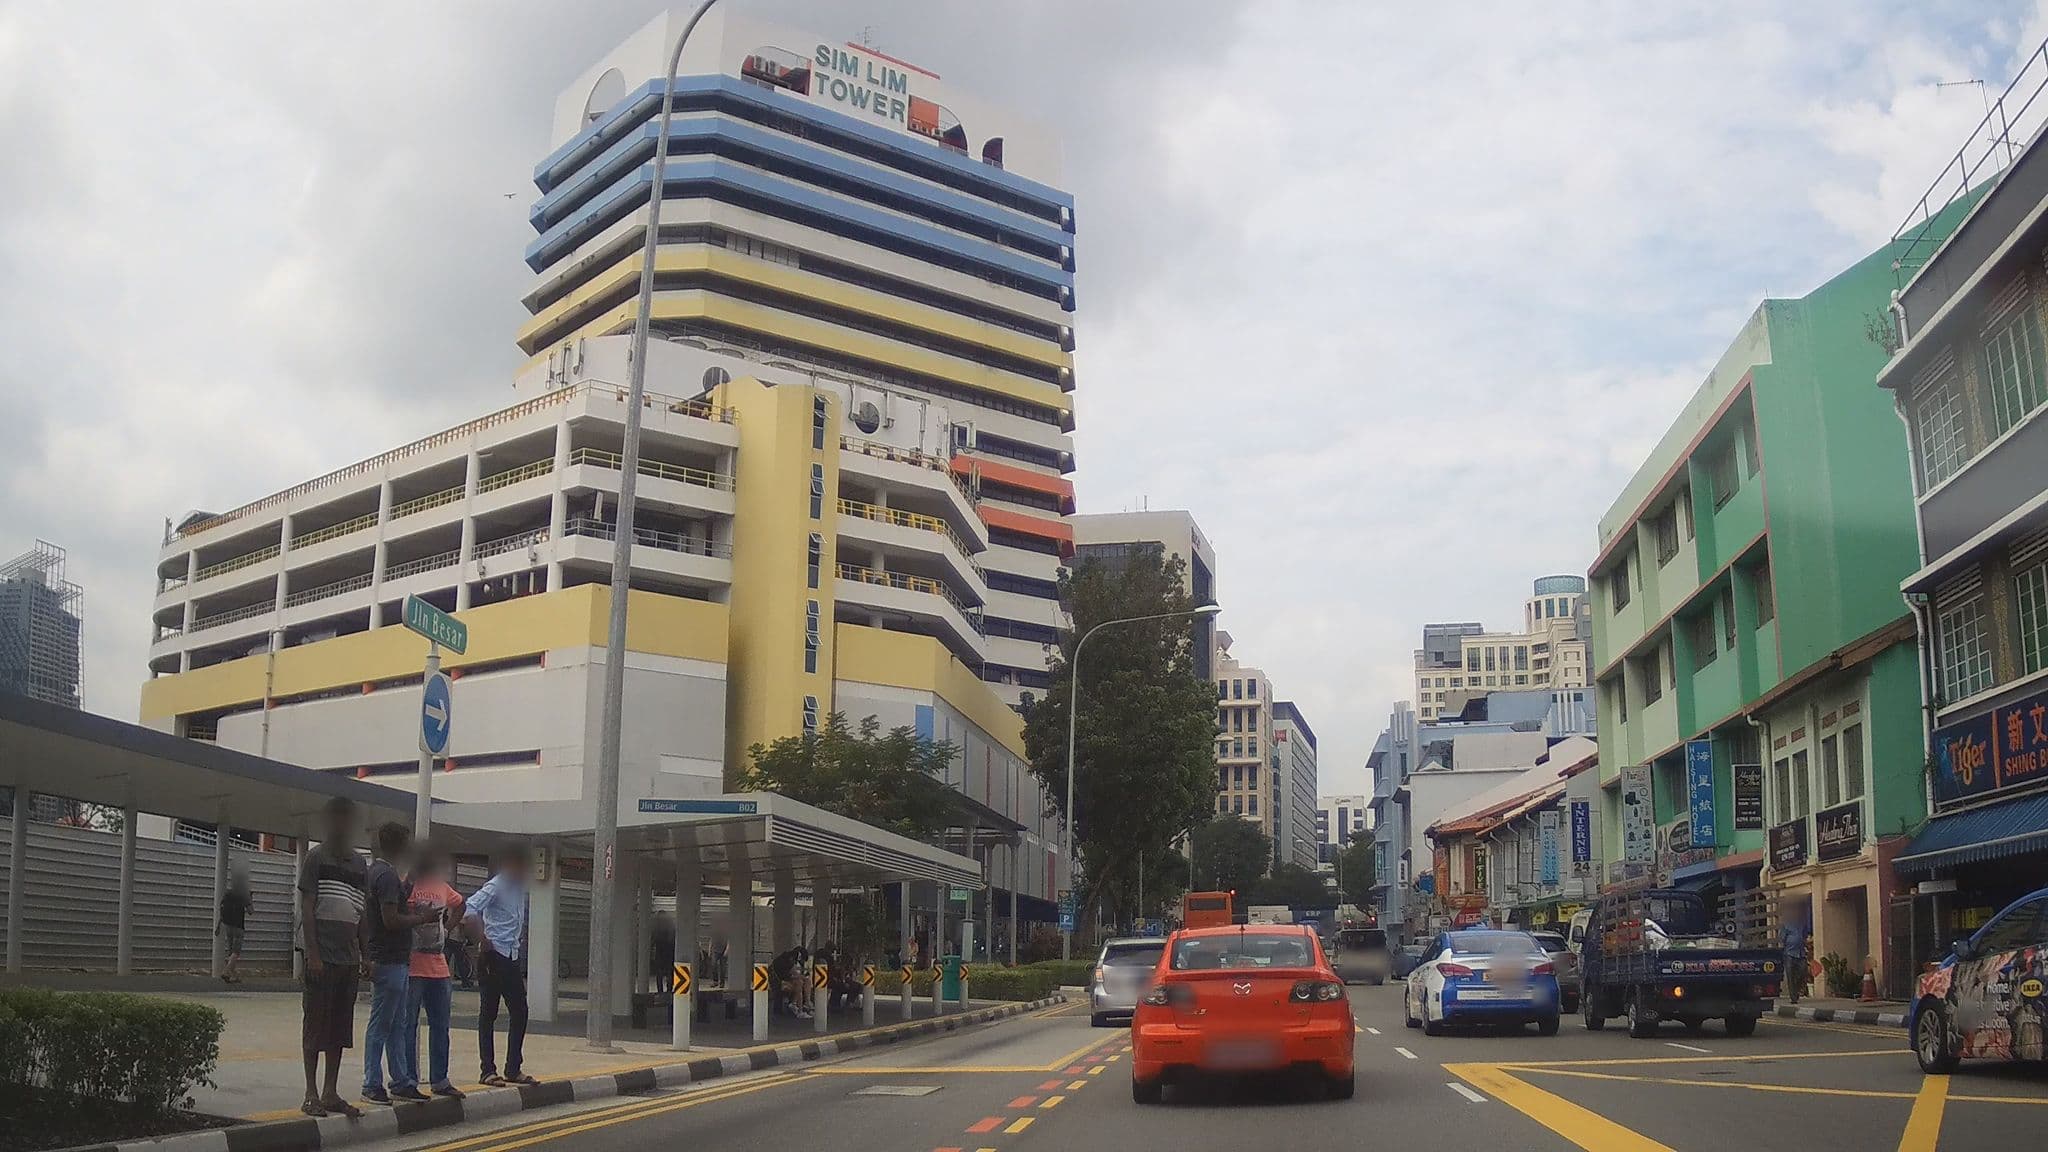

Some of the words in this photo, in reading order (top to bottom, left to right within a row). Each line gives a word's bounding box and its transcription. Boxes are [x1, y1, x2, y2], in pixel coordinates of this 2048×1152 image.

[815, 44, 858, 77] SIM
[866, 61, 907, 95] LIM
[815, 71, 906, 123] TOWER
[412, 602, 429, 631] Jln
[432, 612, 462, 648] Besar
[1689, 745, 1697, 799] HAISING
[1949, 732, 1987, 786] Tiger
[2005, 751, 2037, 777] SHING
[640, 801, 653, 810] Jln
[655, 801, 678, 811] Besar
[738, 803, 755, 812] B02
[1575, 802, 1587, 861] INTERNET
[1819, 816, 1844, 844] Healing
[1842, 812, 1858, 838] Thai
[1574, 862, 1591, 872] 24
[1063, 915, 1070, 924] P
[2023, 984, 2041, 992] IKEA
